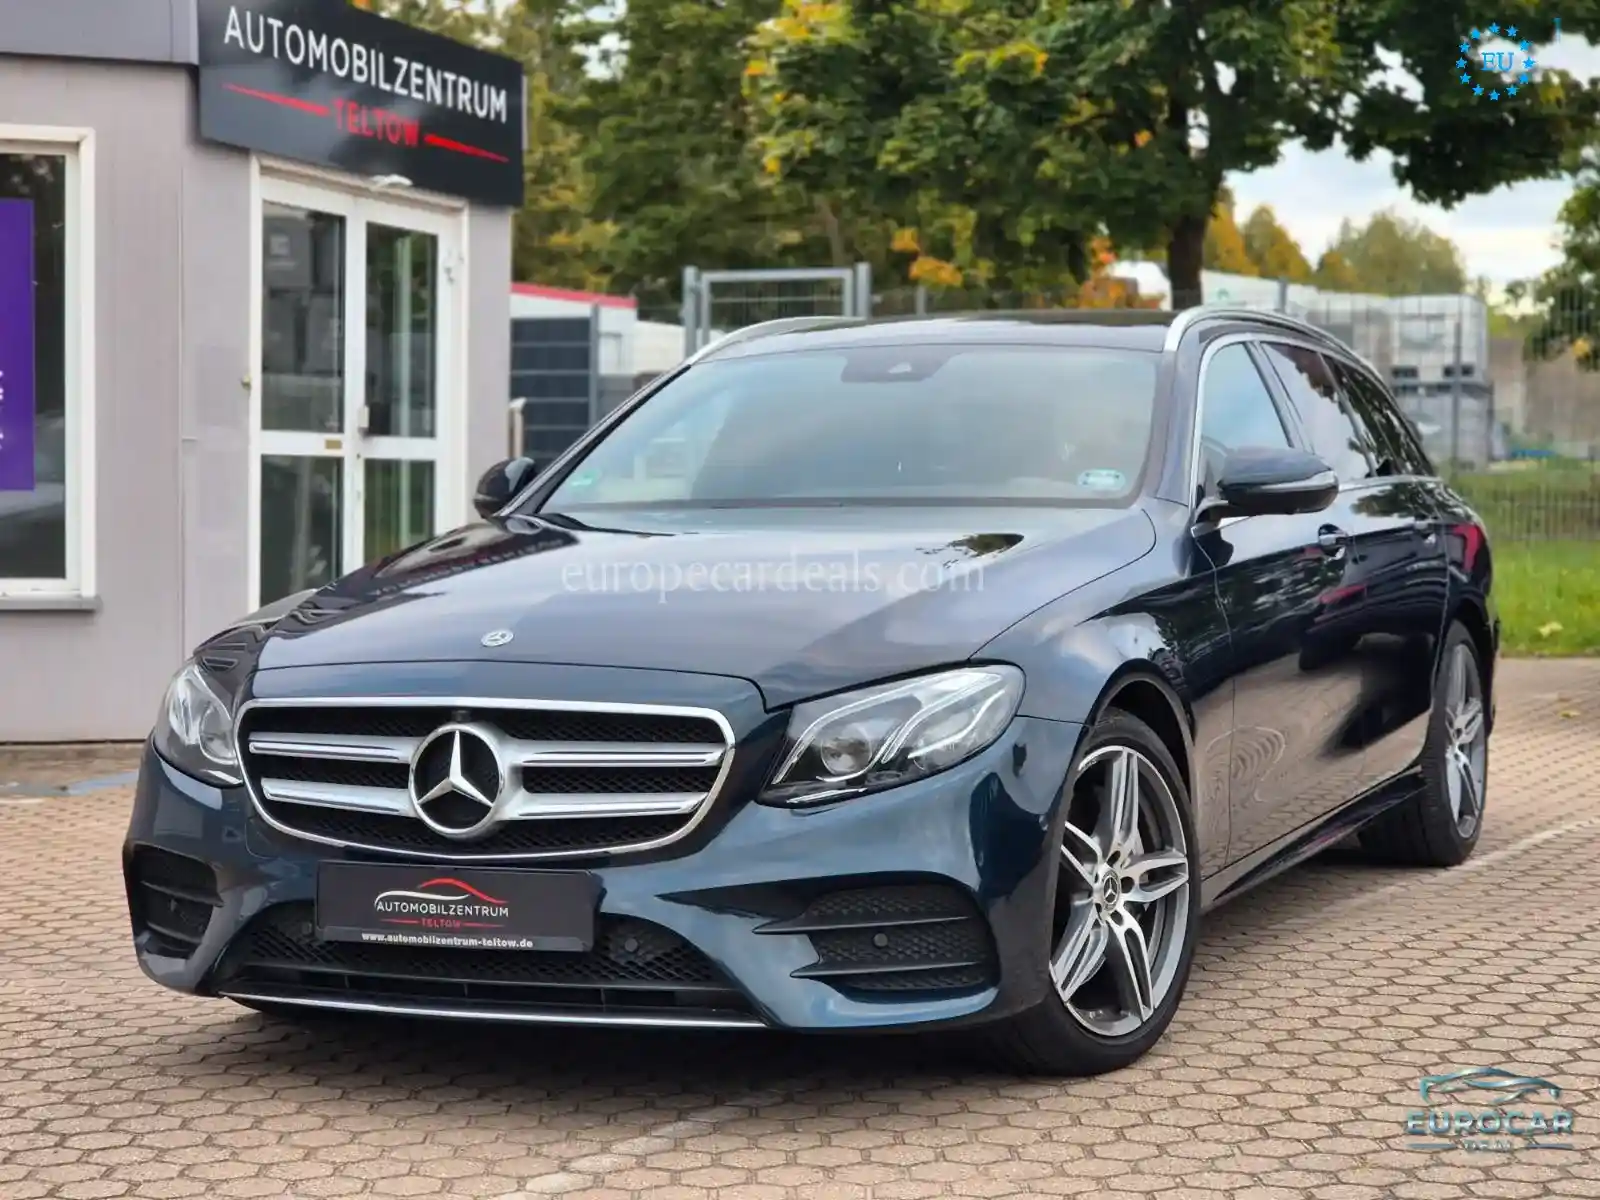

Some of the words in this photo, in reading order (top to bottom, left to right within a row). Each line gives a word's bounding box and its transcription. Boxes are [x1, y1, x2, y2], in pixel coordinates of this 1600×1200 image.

[224, 6, 508, 123] AUTOMOBILZENTRUM
[332, 97, 420, 148] TELTOW
[376, 900, 509, 917] AUTOMOBILZENTRUM
[420, 917, 462, 929] TELTOW
[361, 932, 534, 949] www.automobilzentrum-teltow.de
